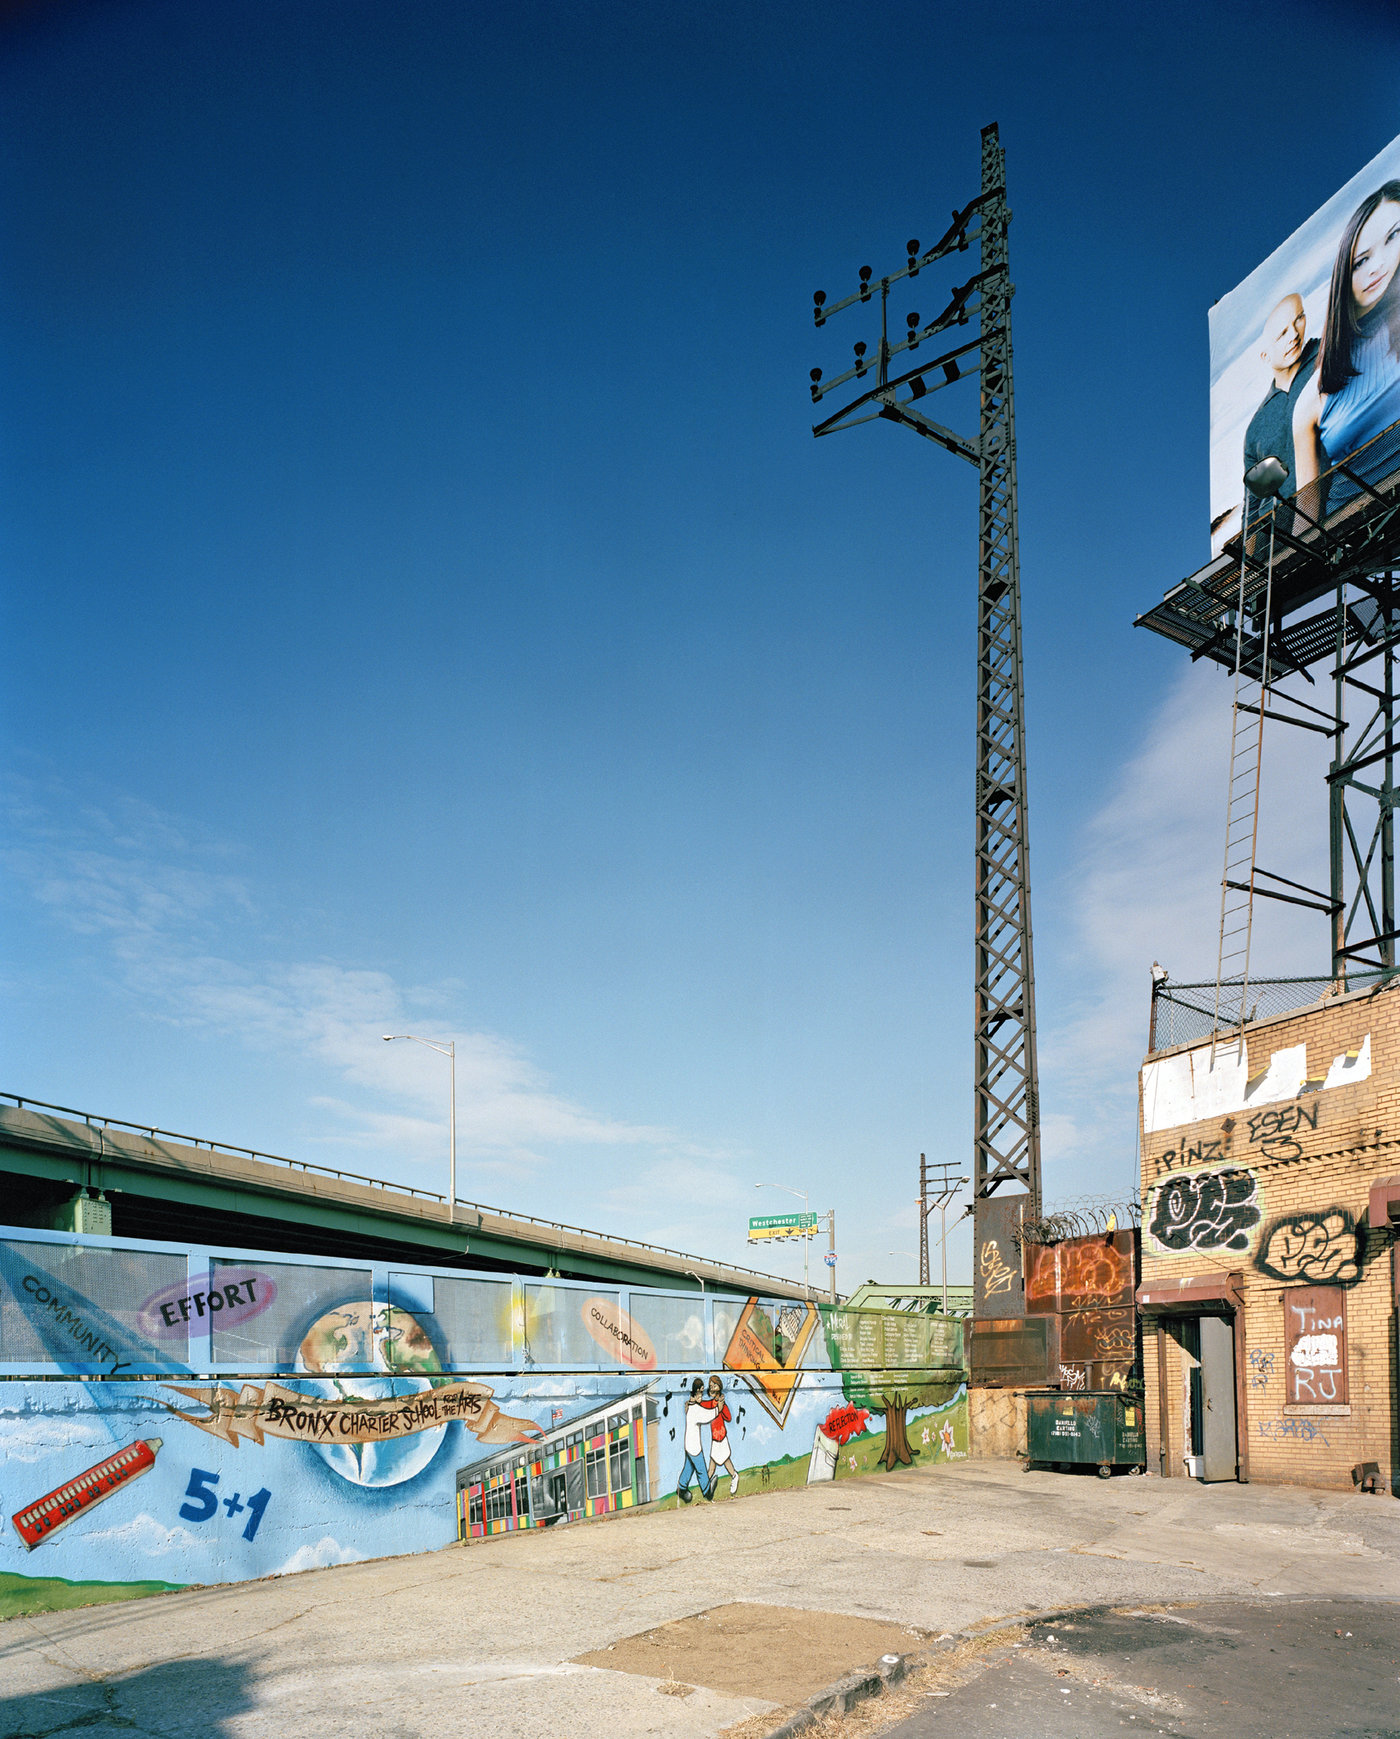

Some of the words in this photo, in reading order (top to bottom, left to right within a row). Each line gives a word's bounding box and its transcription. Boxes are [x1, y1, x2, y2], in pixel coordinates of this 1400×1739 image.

[752, 1218, 796, 1227] Westchester
[159, 1278, 258, 1327] EFFORT
[22, 1275, 131, 1375] COMMUNITY
[590, 1307, 649, 1360] COLLABORATION
[443, 1393, 457, 1404] FOR
[1294, 1368, 1342, 1400] RJ
[402, 1397, 442, 1431] SCHOOL
[441, 1404, 456, 1416] THE
[457, 1389, 482, 1415] ARTS
[265, 1397, 338, 1440] BRONX
[339, 1411, 400, 1435] CHARTER
[829, 1412, 859, 1433] REFLECTION
[178, 1467, 272, 1542] 5+1
